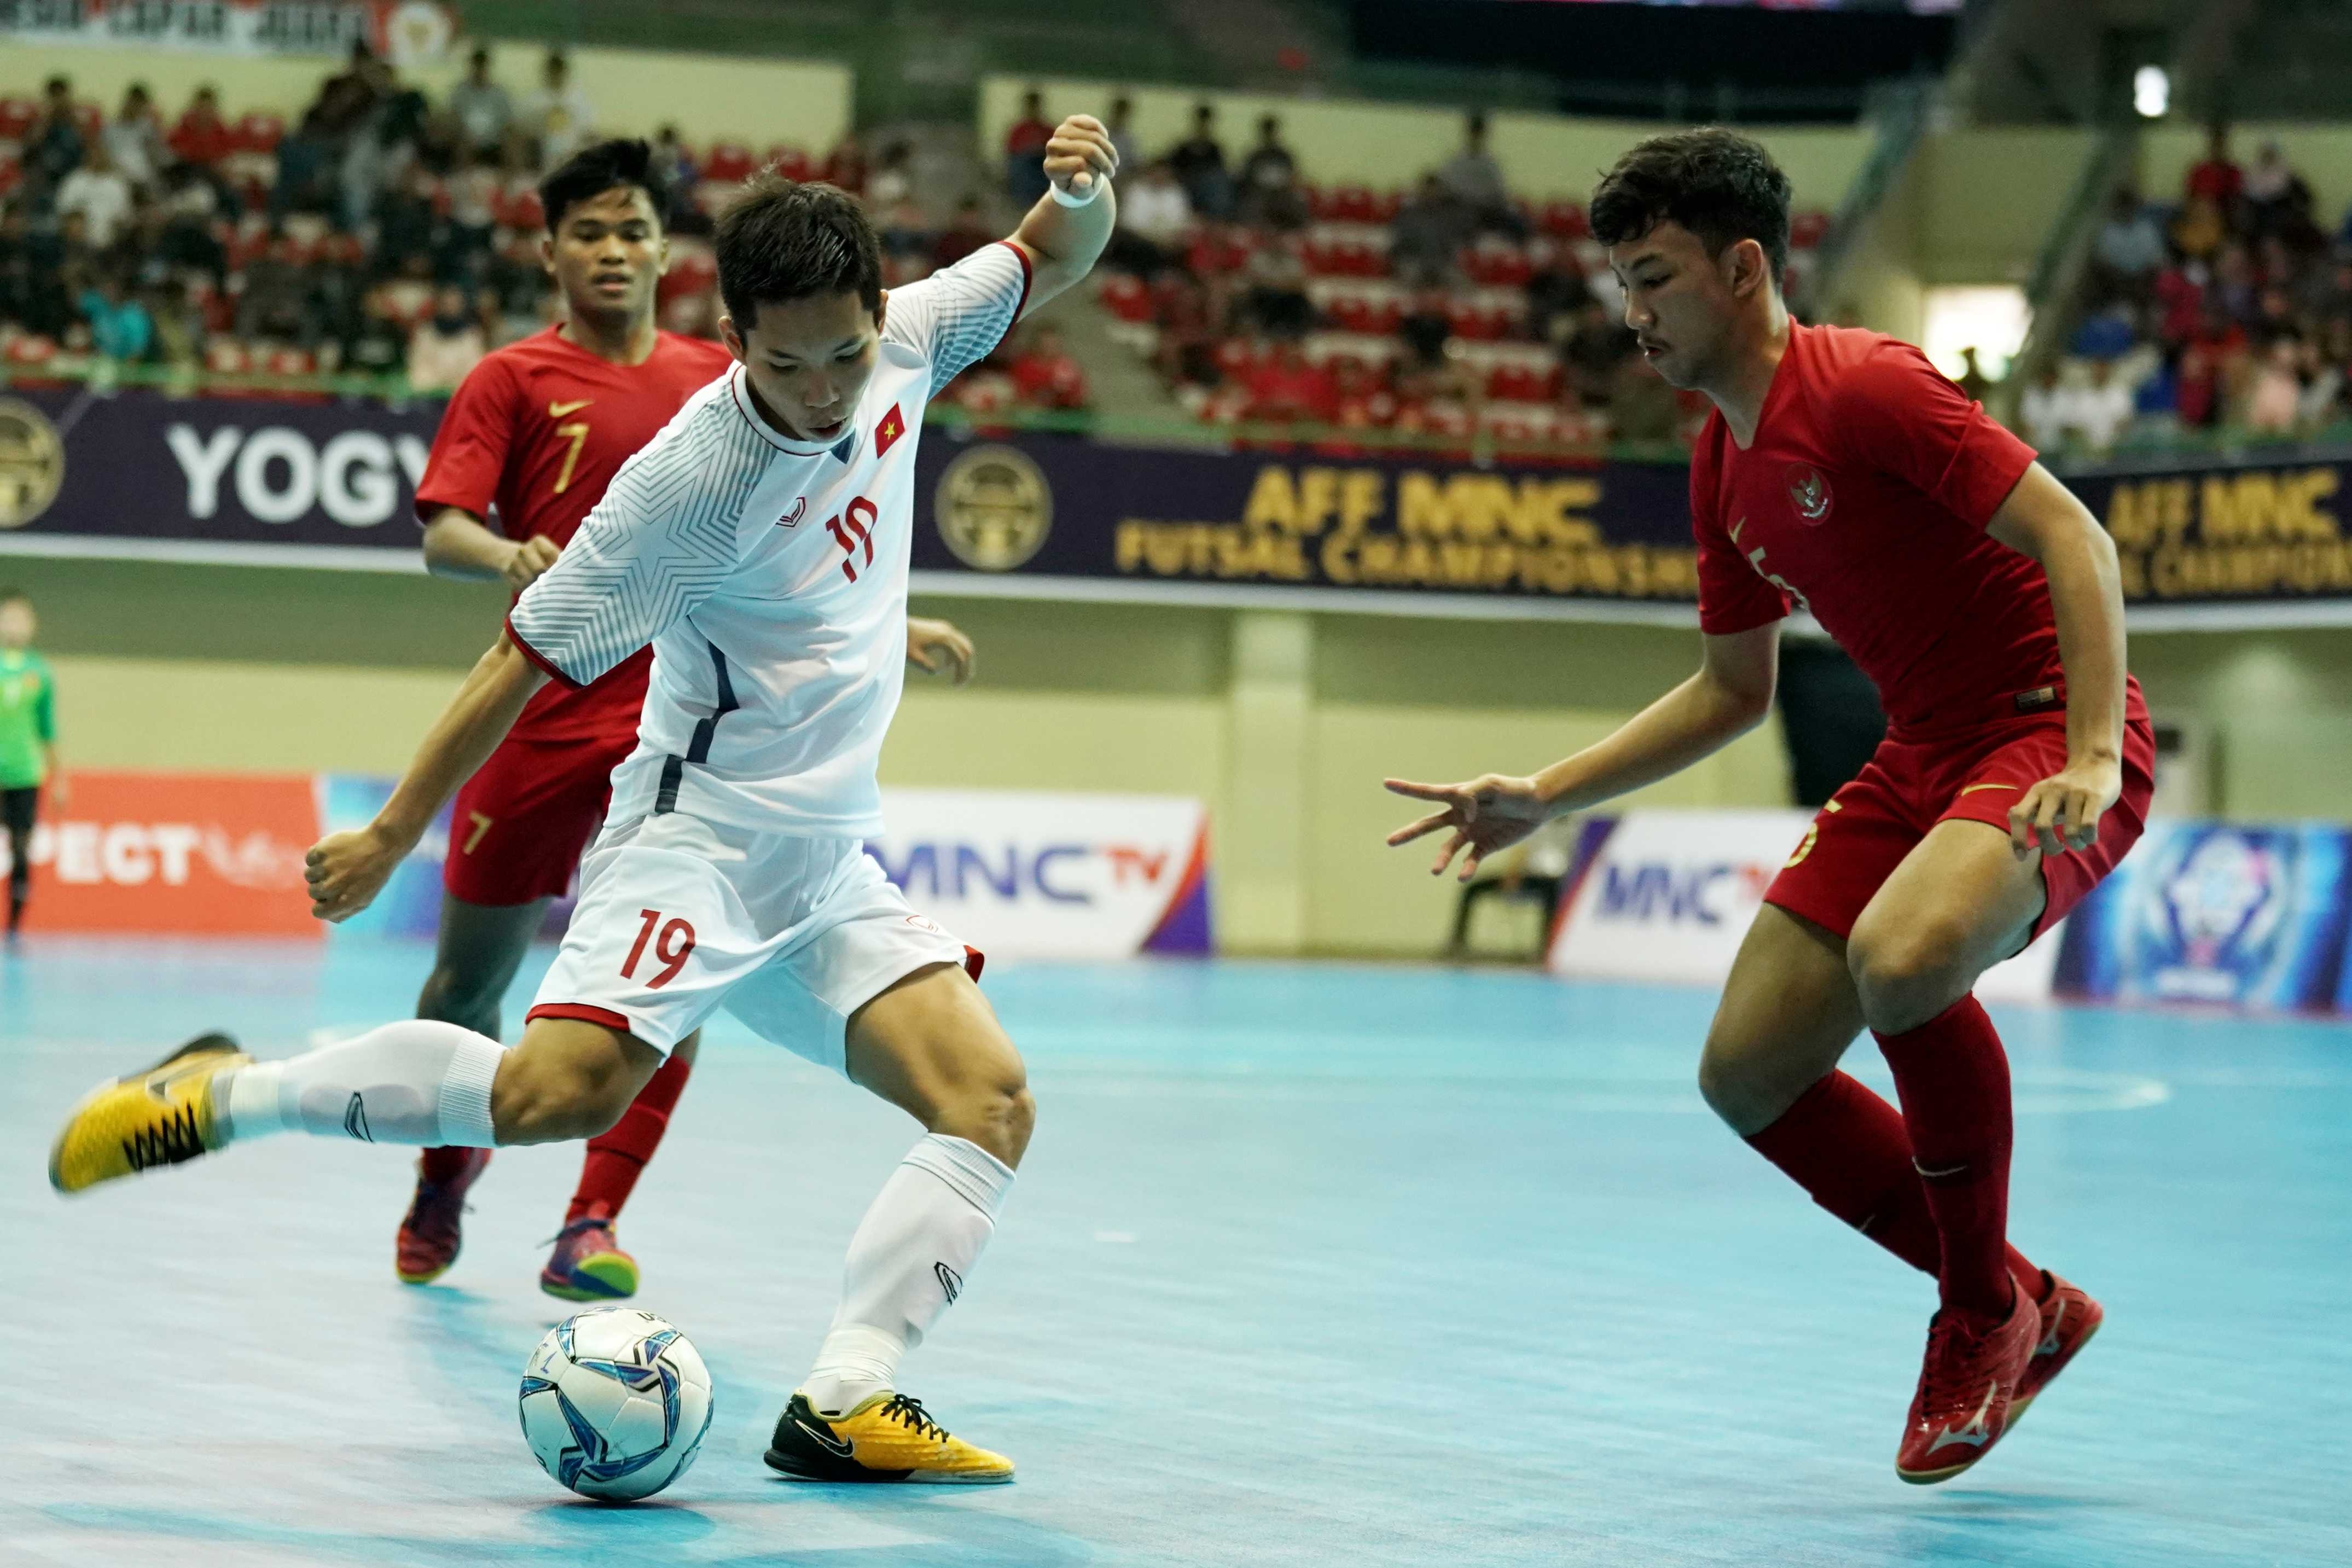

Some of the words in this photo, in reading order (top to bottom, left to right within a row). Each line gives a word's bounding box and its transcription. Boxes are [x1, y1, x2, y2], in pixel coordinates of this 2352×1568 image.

[553, 422, 590, 493] 7
[1244, 464, 1385, 538] AFF
[1397, 469, 1602, 546] MNC
[2106, 477, 2191, 547] AFF
[2200, 466, 2339, 543] MNC
[1114, 517, 1312, 580] FUTSAL
[463, 810, 493, 855] 7
[620, 909, 696, 989] 19
